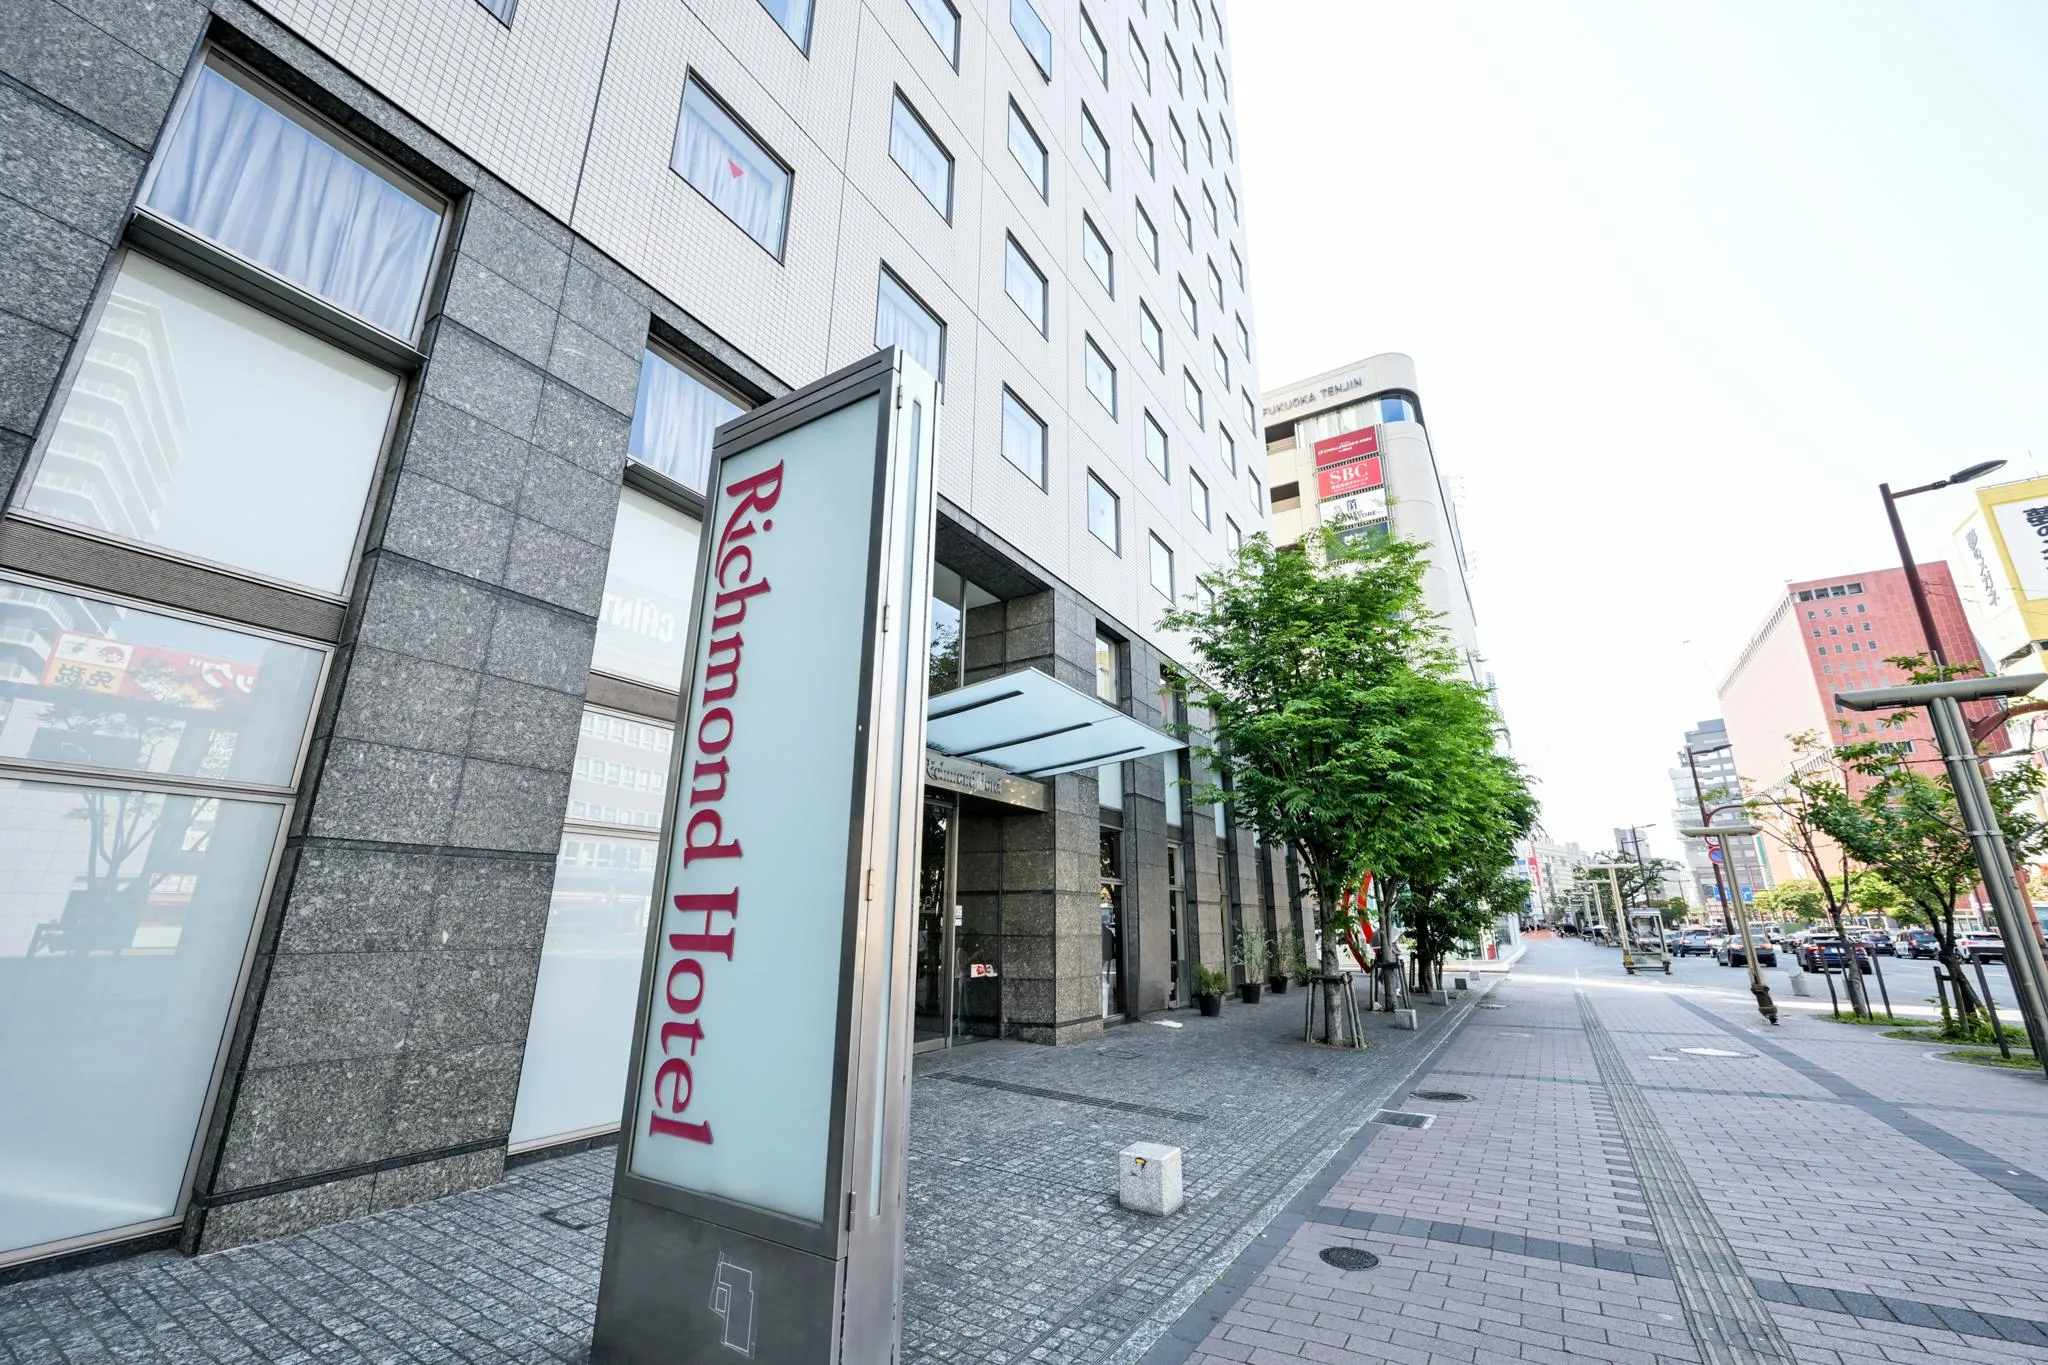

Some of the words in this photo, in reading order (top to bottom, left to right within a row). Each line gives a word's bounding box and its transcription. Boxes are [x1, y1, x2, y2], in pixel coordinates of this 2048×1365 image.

[1263, 392, 1316, 417] FUKUOKA
[1320, 377, 1362, 399] TENJIN
[1330, 463, 1368, 484] SBC
[684, 458, 784, 870] Richmond
[649, 886, 739, 1145] Hotel
